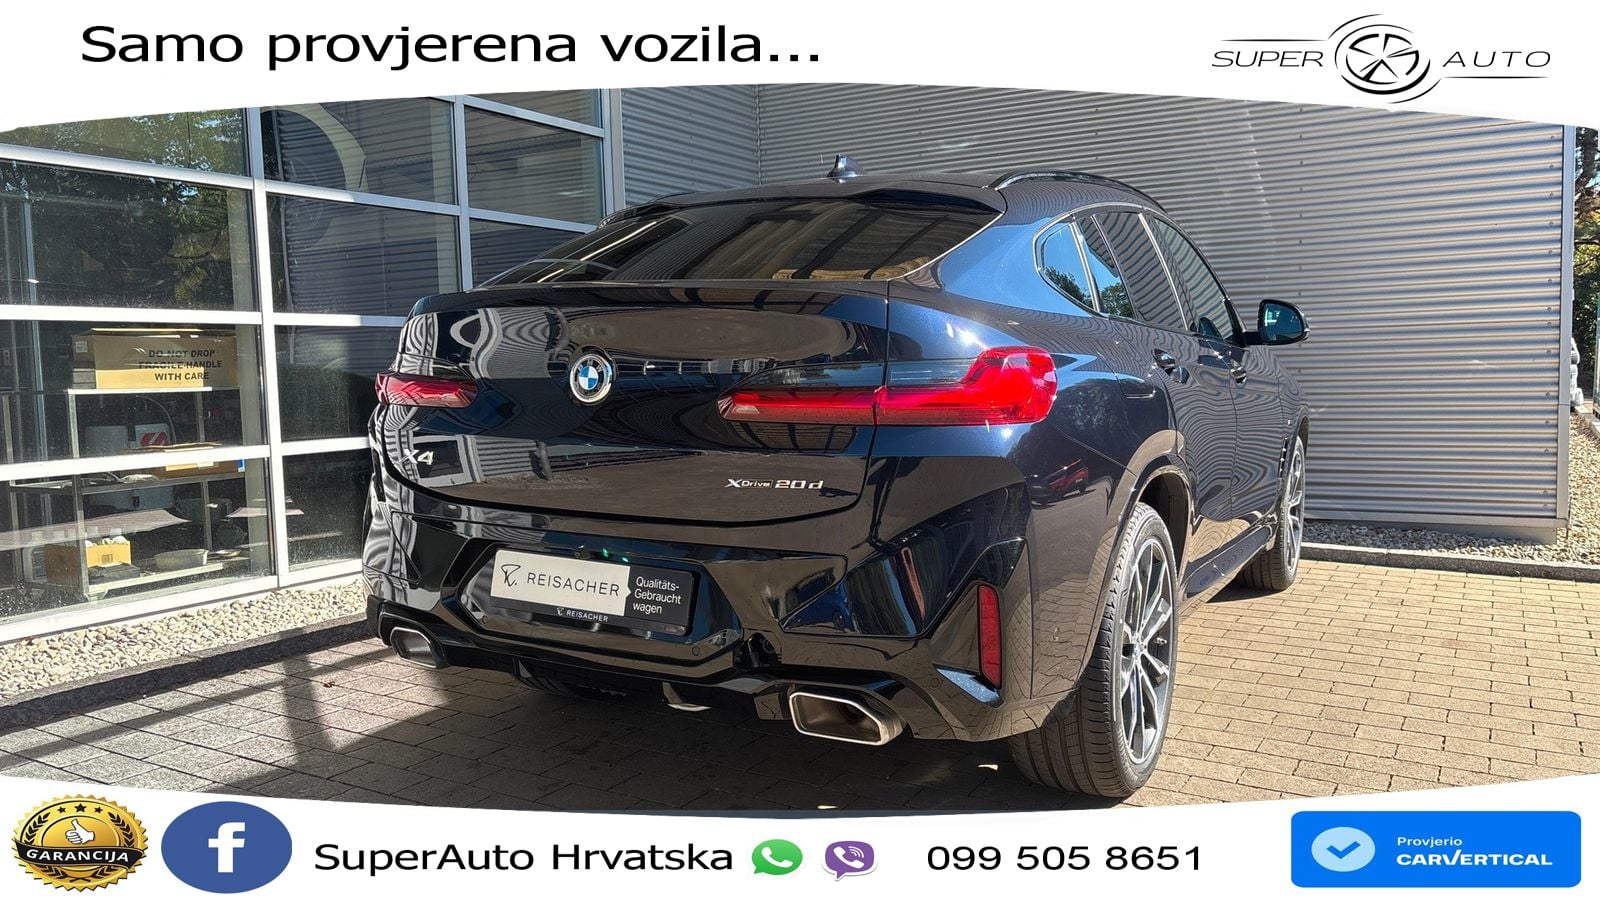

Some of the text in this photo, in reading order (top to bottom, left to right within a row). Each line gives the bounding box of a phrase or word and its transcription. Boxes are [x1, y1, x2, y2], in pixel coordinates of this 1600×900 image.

[148, 349, 215, 358] DO NOT DROP
[154, 372, 210, 381] WITH CARE
[400, 449, 434, 466] X4
[526, 573, 620, 597] REISACHER
[635, 576, 680, 592] Qualitäts-
[634, 589, 682, 605] Gebraucht
[566, 609, 609, 622] REISACHER
[632, 602, 663, 615] wagen
